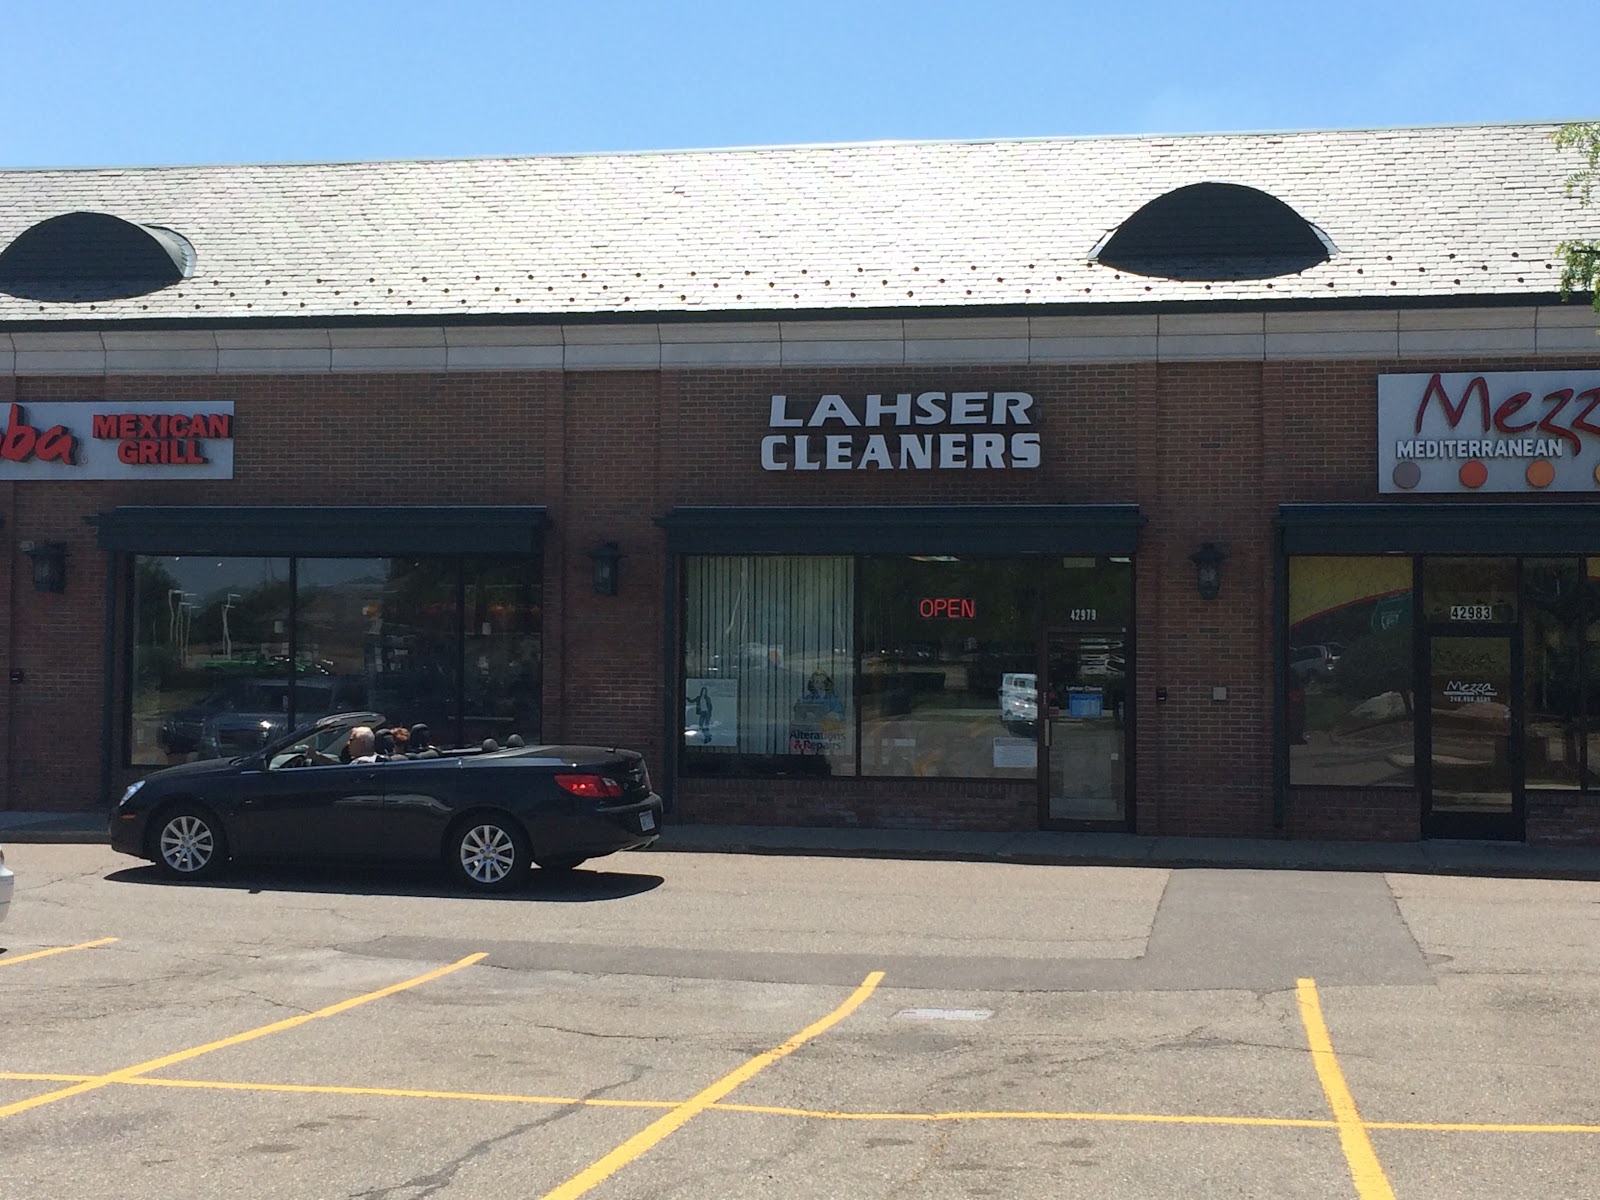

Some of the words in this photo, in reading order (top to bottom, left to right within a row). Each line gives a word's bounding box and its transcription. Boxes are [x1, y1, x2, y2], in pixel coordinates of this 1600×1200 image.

[769, 391, 1034, 427] LAHSER
[0, 402, 75, 466] ba
[92, 413, 233, 439] MEXICAN
[117, 440, 208, 465] GRILL
[760, 432, 1041, 471] CLEANERS
[1396, 438, 1563, 459] MEDITERRANEAN
[920, 598, 976, 618] OPEN
[1070, 608, 1097, 621] 42979
[1451, 606, 1491, 619] 42983
[1446, 680, 1495, 696] Mezza
[789, 730, 846, 741] Alterations
